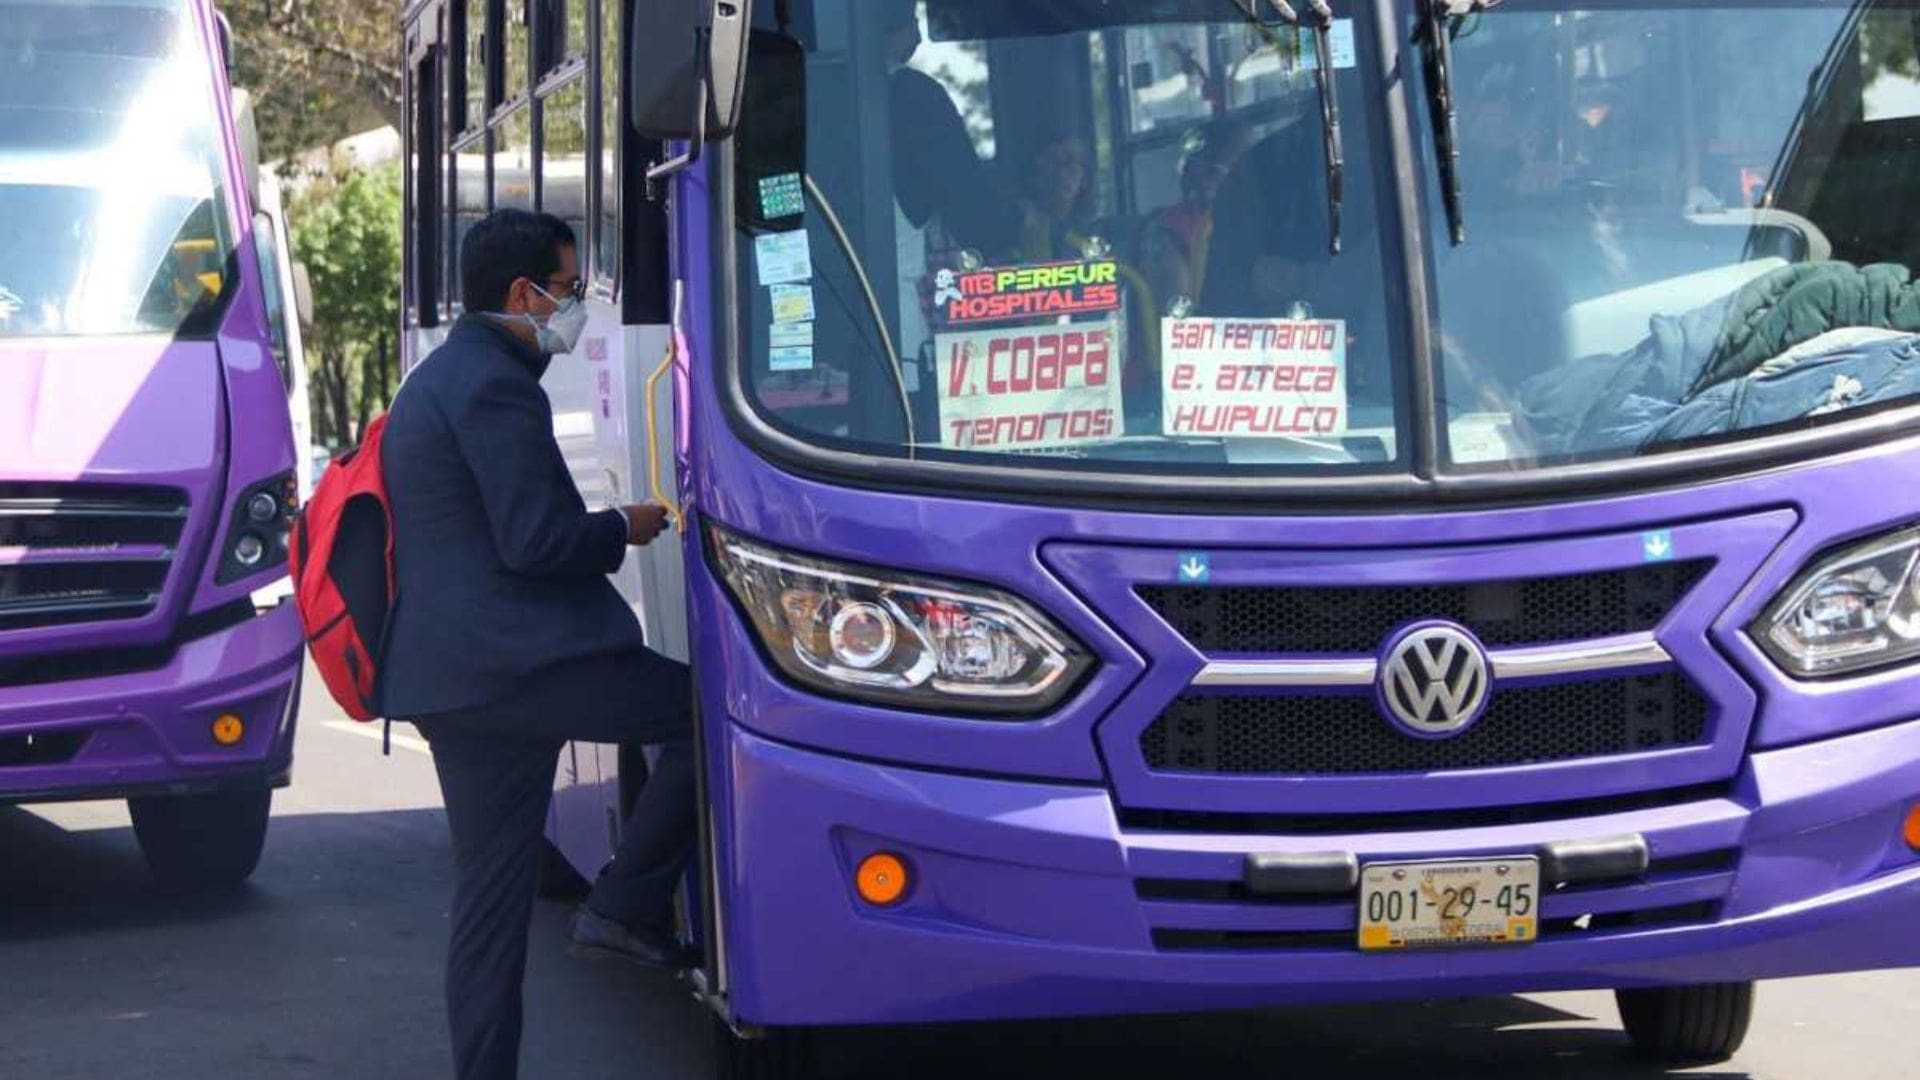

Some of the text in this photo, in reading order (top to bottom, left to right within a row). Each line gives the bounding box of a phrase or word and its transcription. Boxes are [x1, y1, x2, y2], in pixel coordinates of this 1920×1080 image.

[997, 262, 1117, 292] PERISUR
[950, 284, 1117, 319] HOSPITALES
[949, 341, 977, 397] V.
[1173, 404, 1338, 433] HUIPULCO
[1369, 884, 1532, 923] 001-29-45
